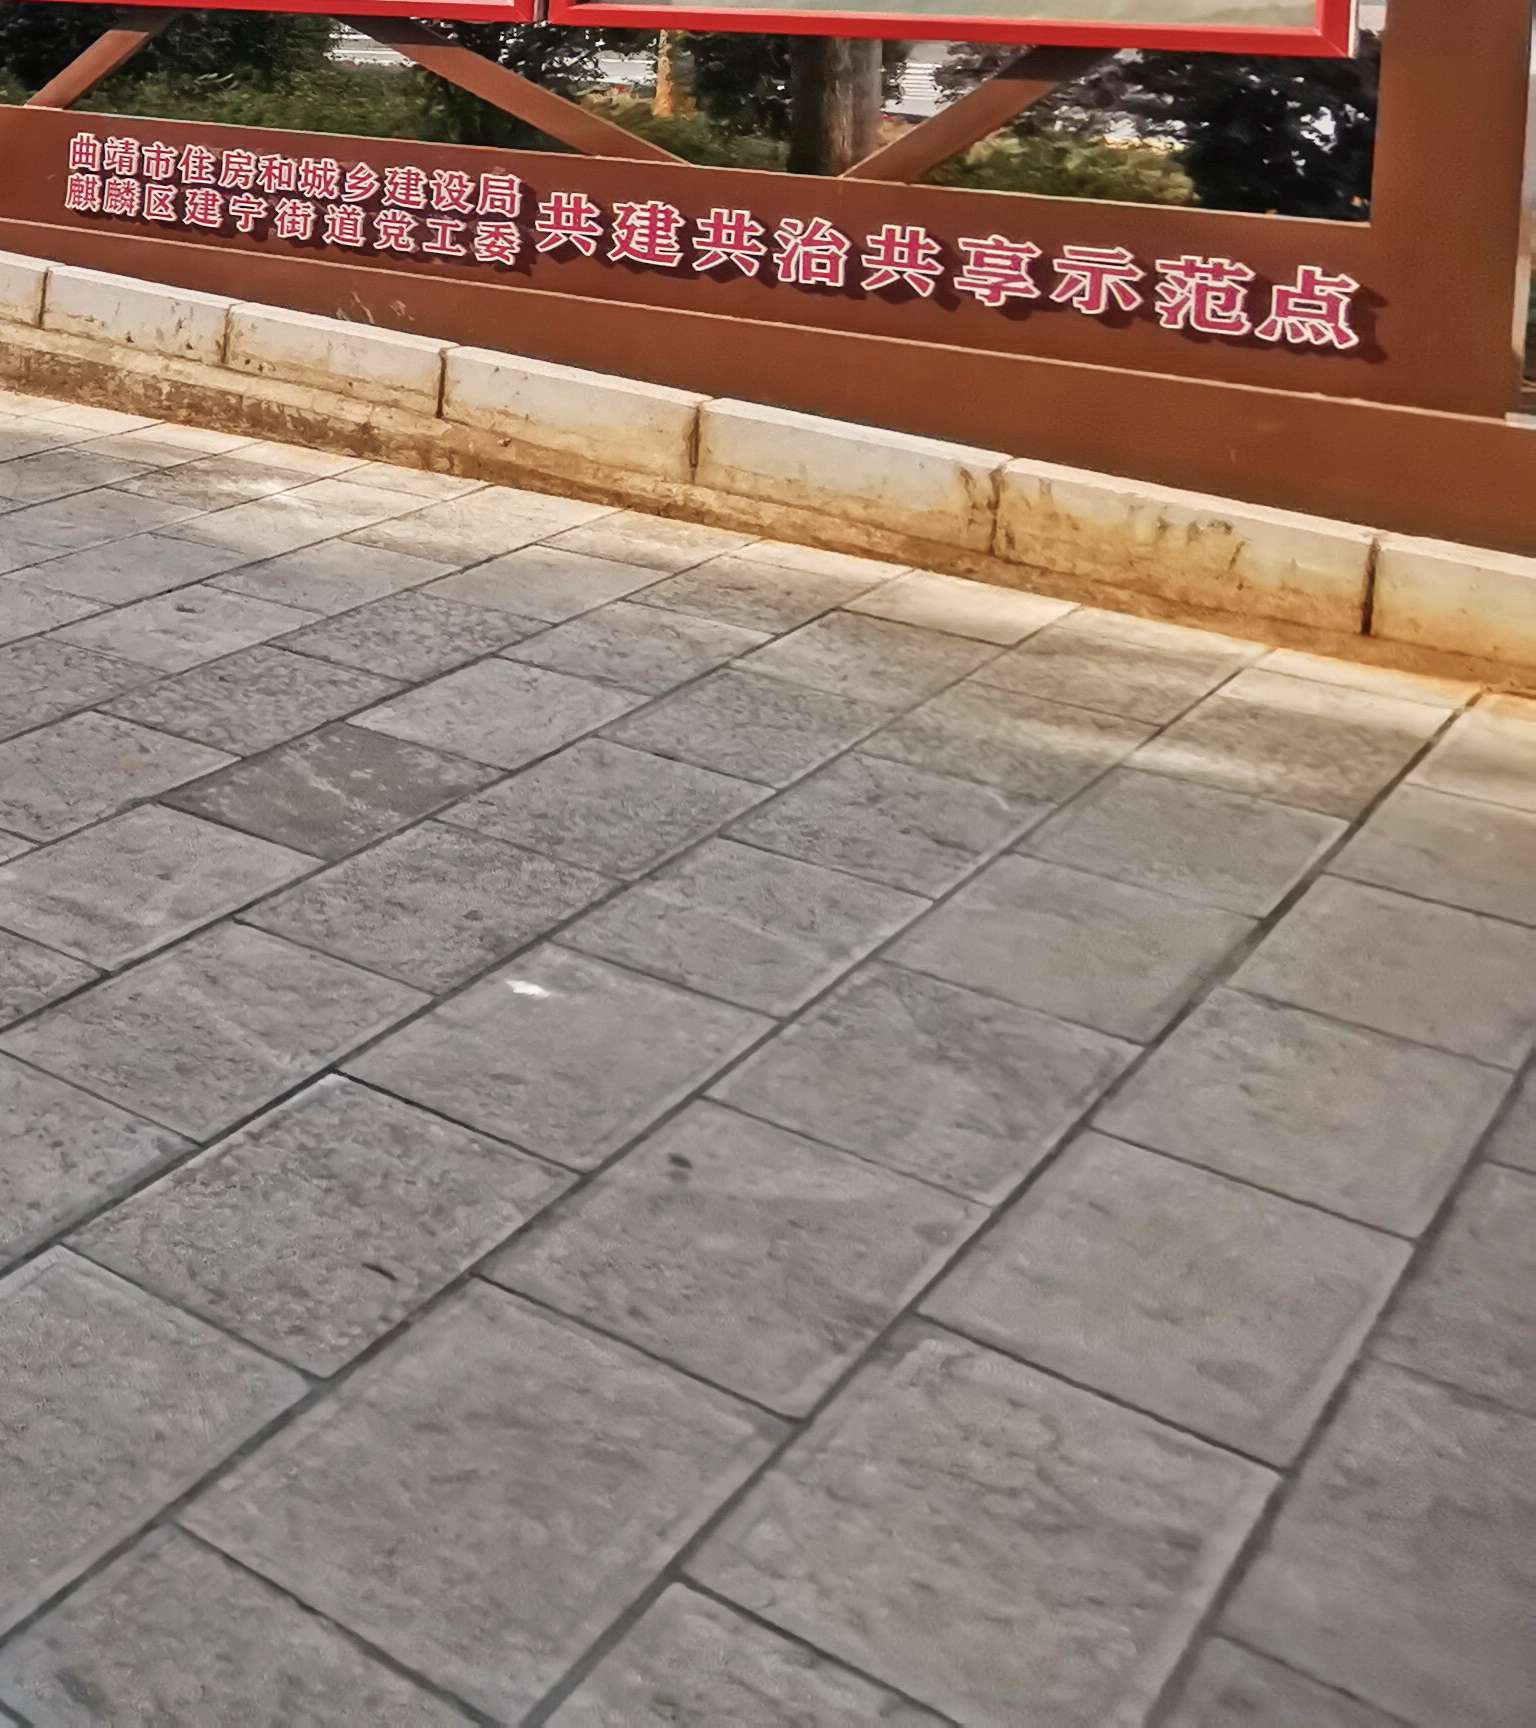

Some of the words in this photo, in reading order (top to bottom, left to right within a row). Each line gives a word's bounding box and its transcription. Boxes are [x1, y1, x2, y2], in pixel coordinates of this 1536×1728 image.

[64, 173, 523, 265] 麒麟区建宁街道党工委
[68, 133, 525, 218] 曲靖市住房和城乡建设局
[534, 191, 1361, 347] 共建共治共享示范点
